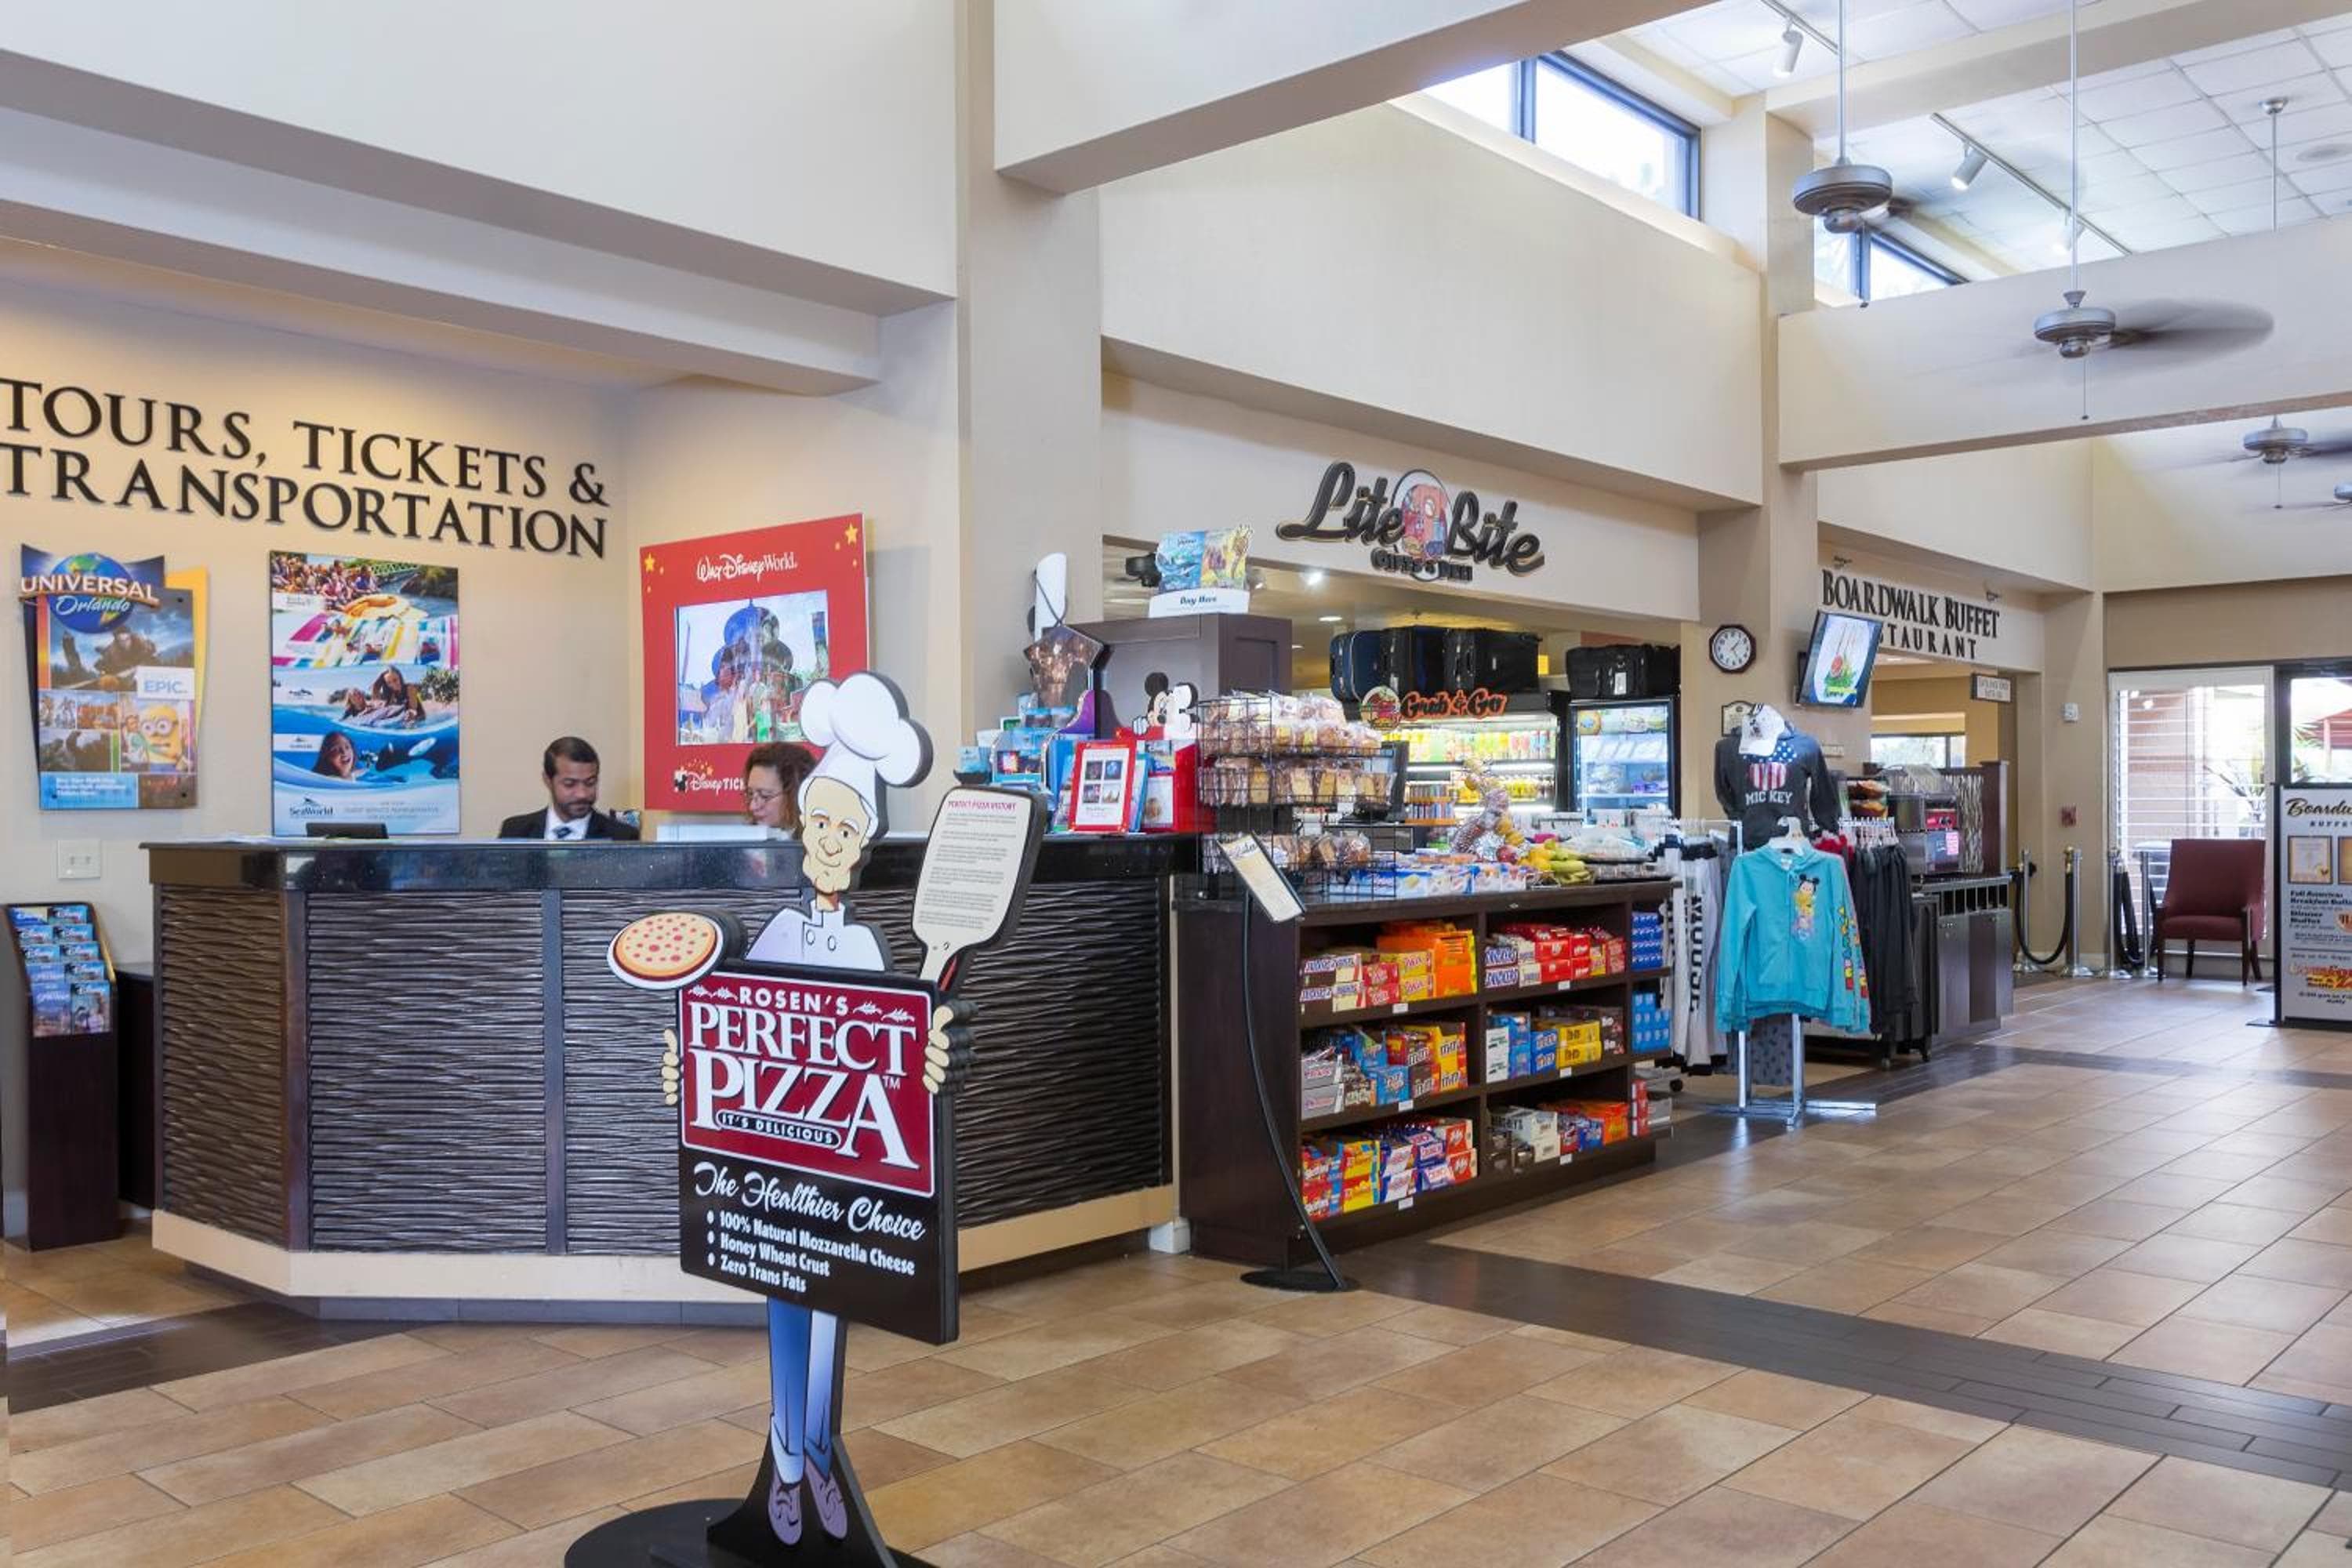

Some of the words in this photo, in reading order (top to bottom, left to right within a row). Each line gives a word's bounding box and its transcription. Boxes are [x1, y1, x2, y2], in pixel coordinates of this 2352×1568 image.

[0, 378, 266, 469] TOURS,
[292, 420, 547, 498] TICKETS
[569, 463, 609, 506] &
[0, 442, 608, 558] TRANSPORTATION
[1275, 461, 1404, 545] Lite
[1446, 490, 1545, 576] Bite
[21, 574, 159, 601] UNIVERSAL
[720, 553, 764, 583] Disney
[56, 596, 130, 615] Orlando
[1822, 569, 1940, 629] BOARDWALK
[1944, 597, 2000, 639] BUFFET
[1879, 622, 1976, 659] TAURANT
[1468, 687, 1507, 719] Go
[739, 986, 848, 1015] ROSEN'S
[688, 1001, 916, 1076] PERFECT
[688, 1048, 920, 1170] PIZZA
[721, 1113, 748, 1128] IT'S
[756, 1120, 833, 1144] DELICIOUS
[694, 1161, 739, 1197] The
[741, 1171, 845, 1220] Healthier
[848, 1196, 926, 1241] Choice
[720, 1210, 751, 1233] 100%
[753, 1218, 797, 1246] Natural
[799, 1229, 867, 1264] Mozzarella
[869, 1247, 915, 1276] Cheese
[720, 1232, 757, 1260] Honey
[759, 1242, 797, 1269] Wheat
[799, 1253, 830, 1277] Crust
[720, 1254, 746, 1276] Zero
[748, 1261, 780, 1286] Trans
[782, 1270, 807, 1293] Fats
